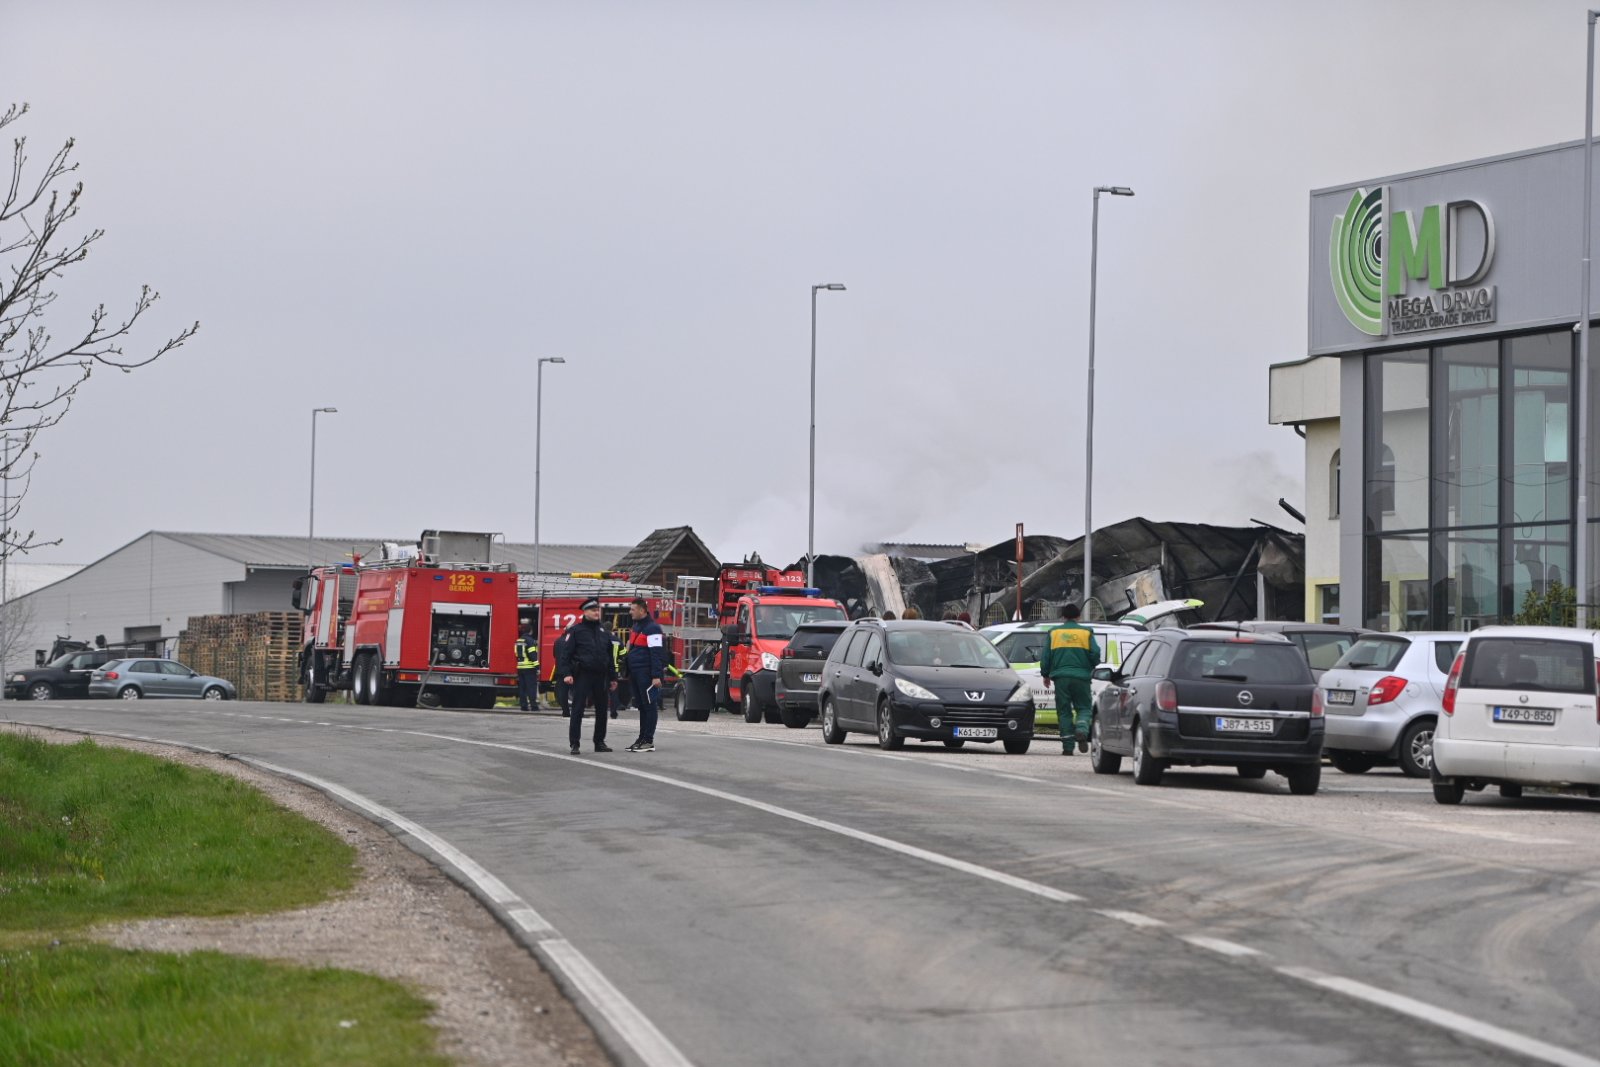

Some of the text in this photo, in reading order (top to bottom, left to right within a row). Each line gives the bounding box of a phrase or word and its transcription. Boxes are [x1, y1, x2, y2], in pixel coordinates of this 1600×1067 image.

[1388, 200, 1495, 296] MD
[1388, 288, 1491, 318] MEGA DRVO
[1391, 309, 1492, 332] TRADICIJA OBRADE DRVETA
[449, 573, 475, 586] 123
[661, 599, 673, 611] 123
[552, 614, 584, 630] 12
[1223, 719, 1271, 731] J87-A-515
